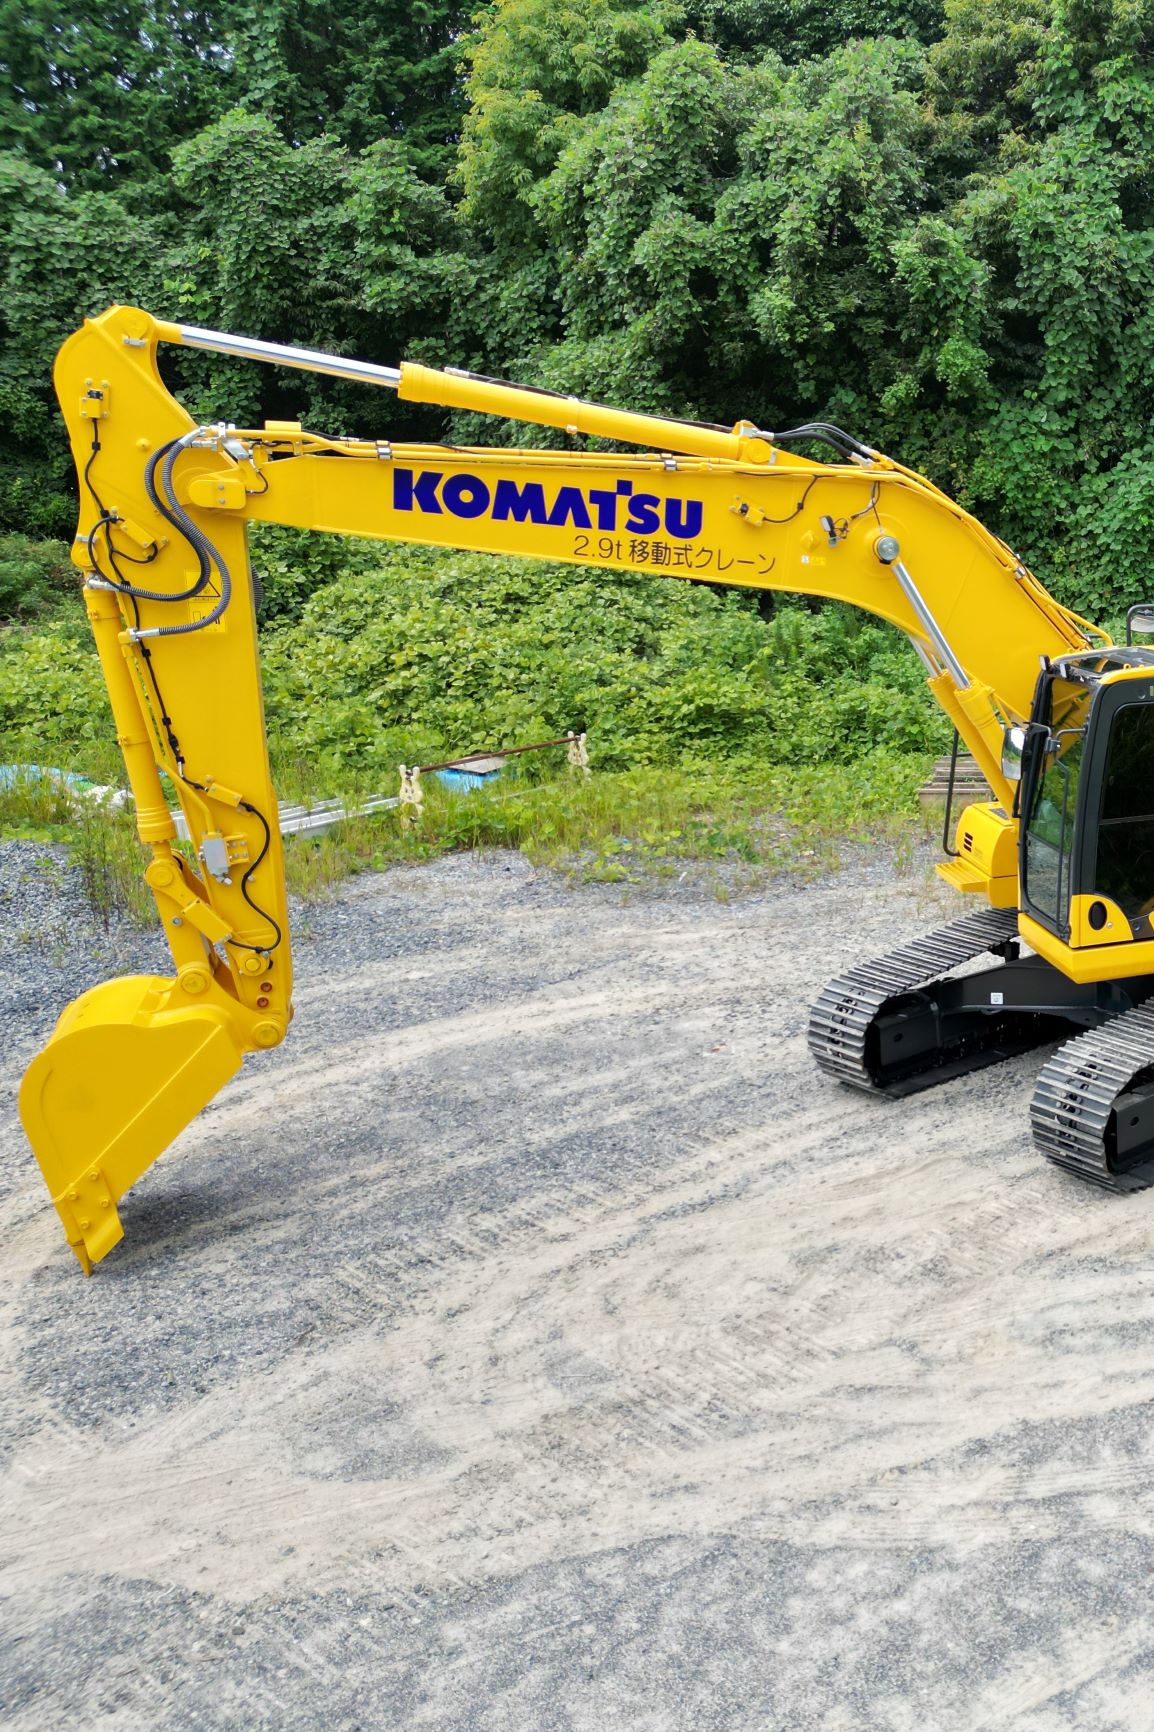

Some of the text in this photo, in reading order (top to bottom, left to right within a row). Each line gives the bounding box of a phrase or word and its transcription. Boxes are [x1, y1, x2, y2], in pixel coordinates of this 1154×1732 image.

[393, 468, 703, 538] KOMATSU
[574, 535, 776, 575] 2.9t 移動式クレーン
